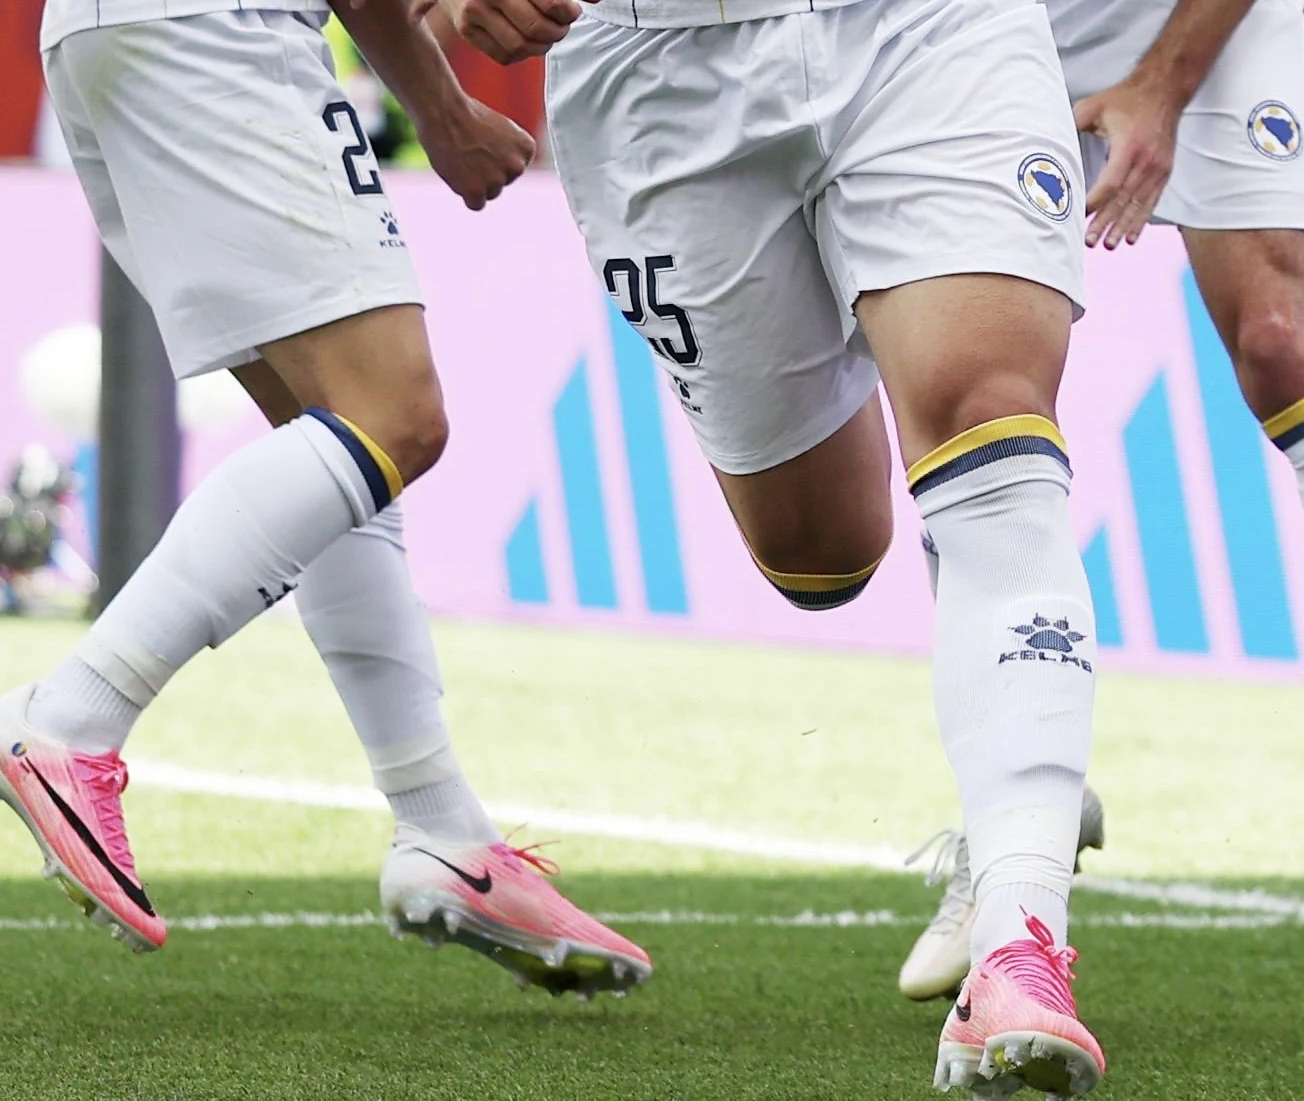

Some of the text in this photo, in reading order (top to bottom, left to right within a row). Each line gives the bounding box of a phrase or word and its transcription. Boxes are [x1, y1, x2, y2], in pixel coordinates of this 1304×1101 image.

[322, 101, 386, 197] 2
[602, 255, 703, 367] 25
[998, 650, 1093, 673] KELME
